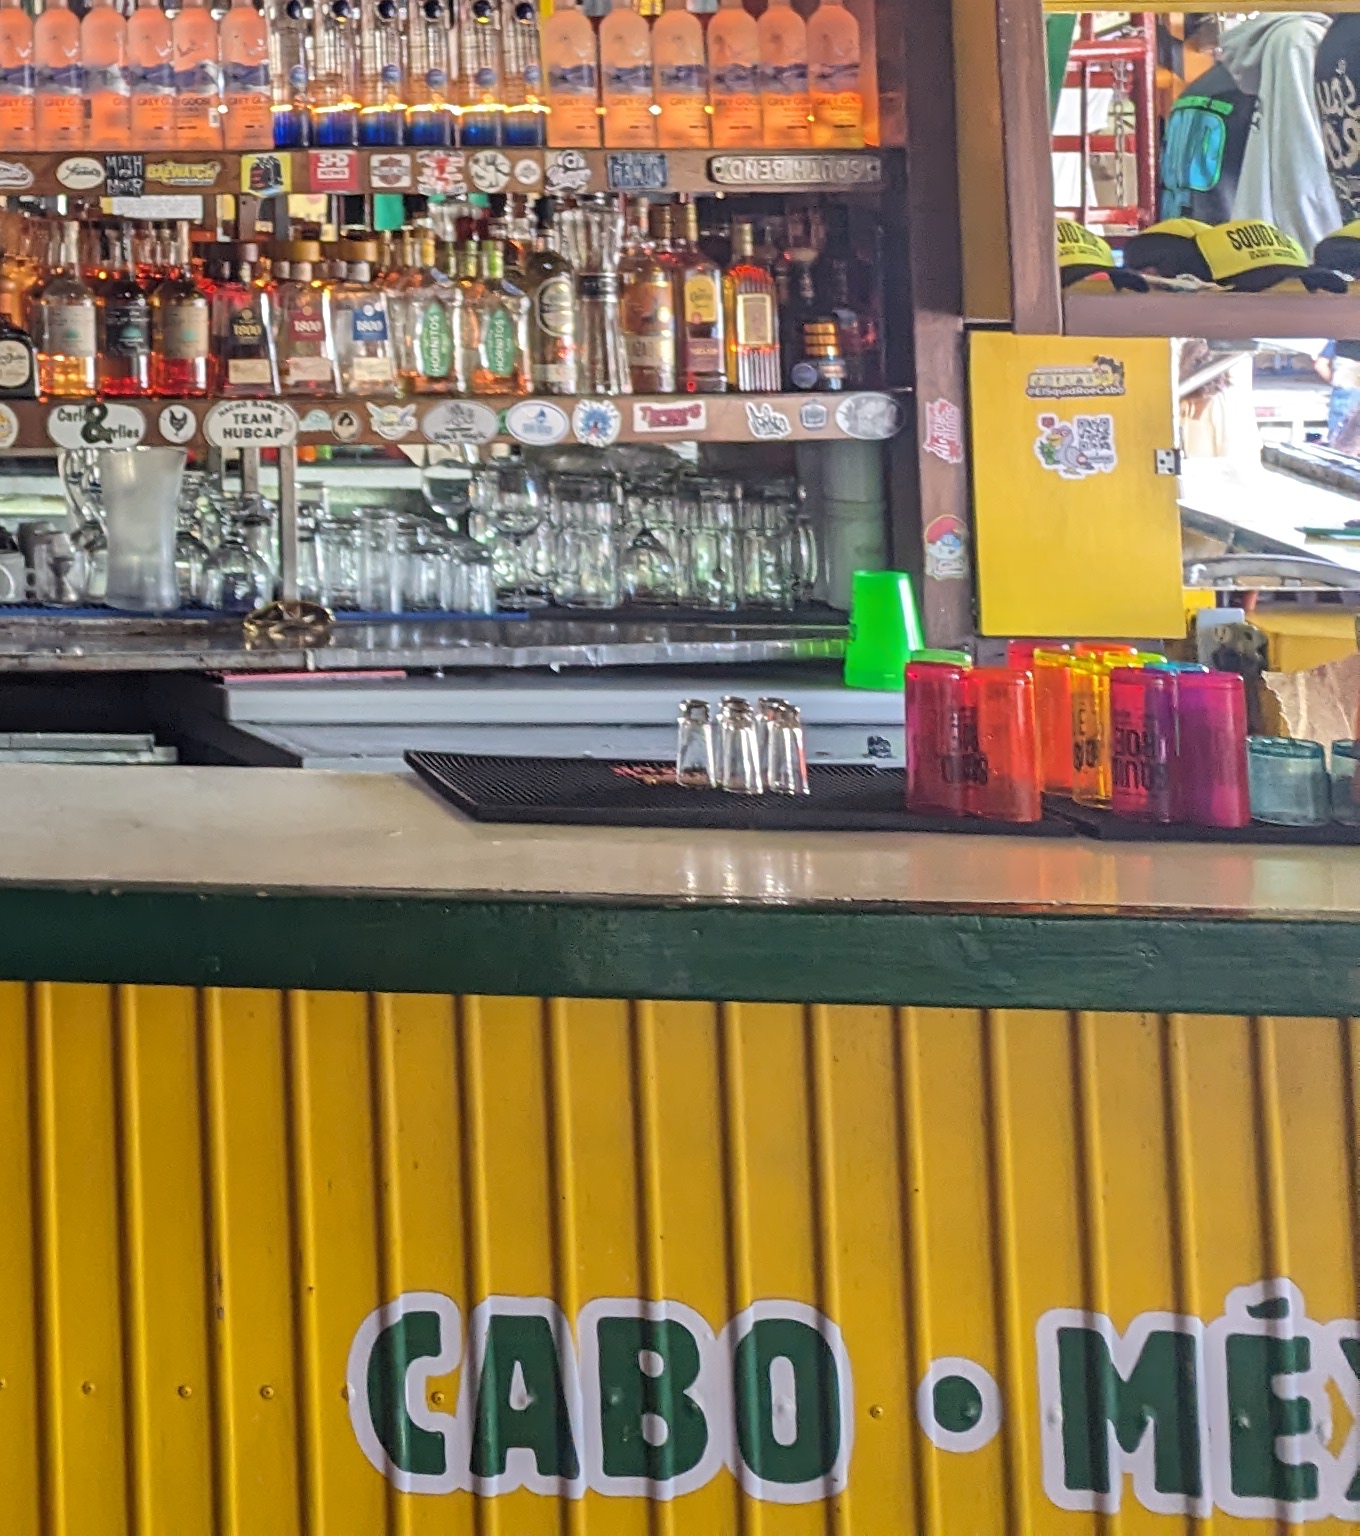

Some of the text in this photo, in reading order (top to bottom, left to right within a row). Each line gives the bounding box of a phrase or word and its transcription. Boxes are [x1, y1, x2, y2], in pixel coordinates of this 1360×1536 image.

[1226, 223, 1272, 251] SQUID
[293, 320, 322, 334] 1800
[354, 320, 384, 333] 1800
[428, 322, 443, 376] HORNITOS
[232, 412, 273, 425] TEAM
[222, 426, 284, 440] HUBCAP
[356, 1290, 1360, 1508] CABO MÉ
